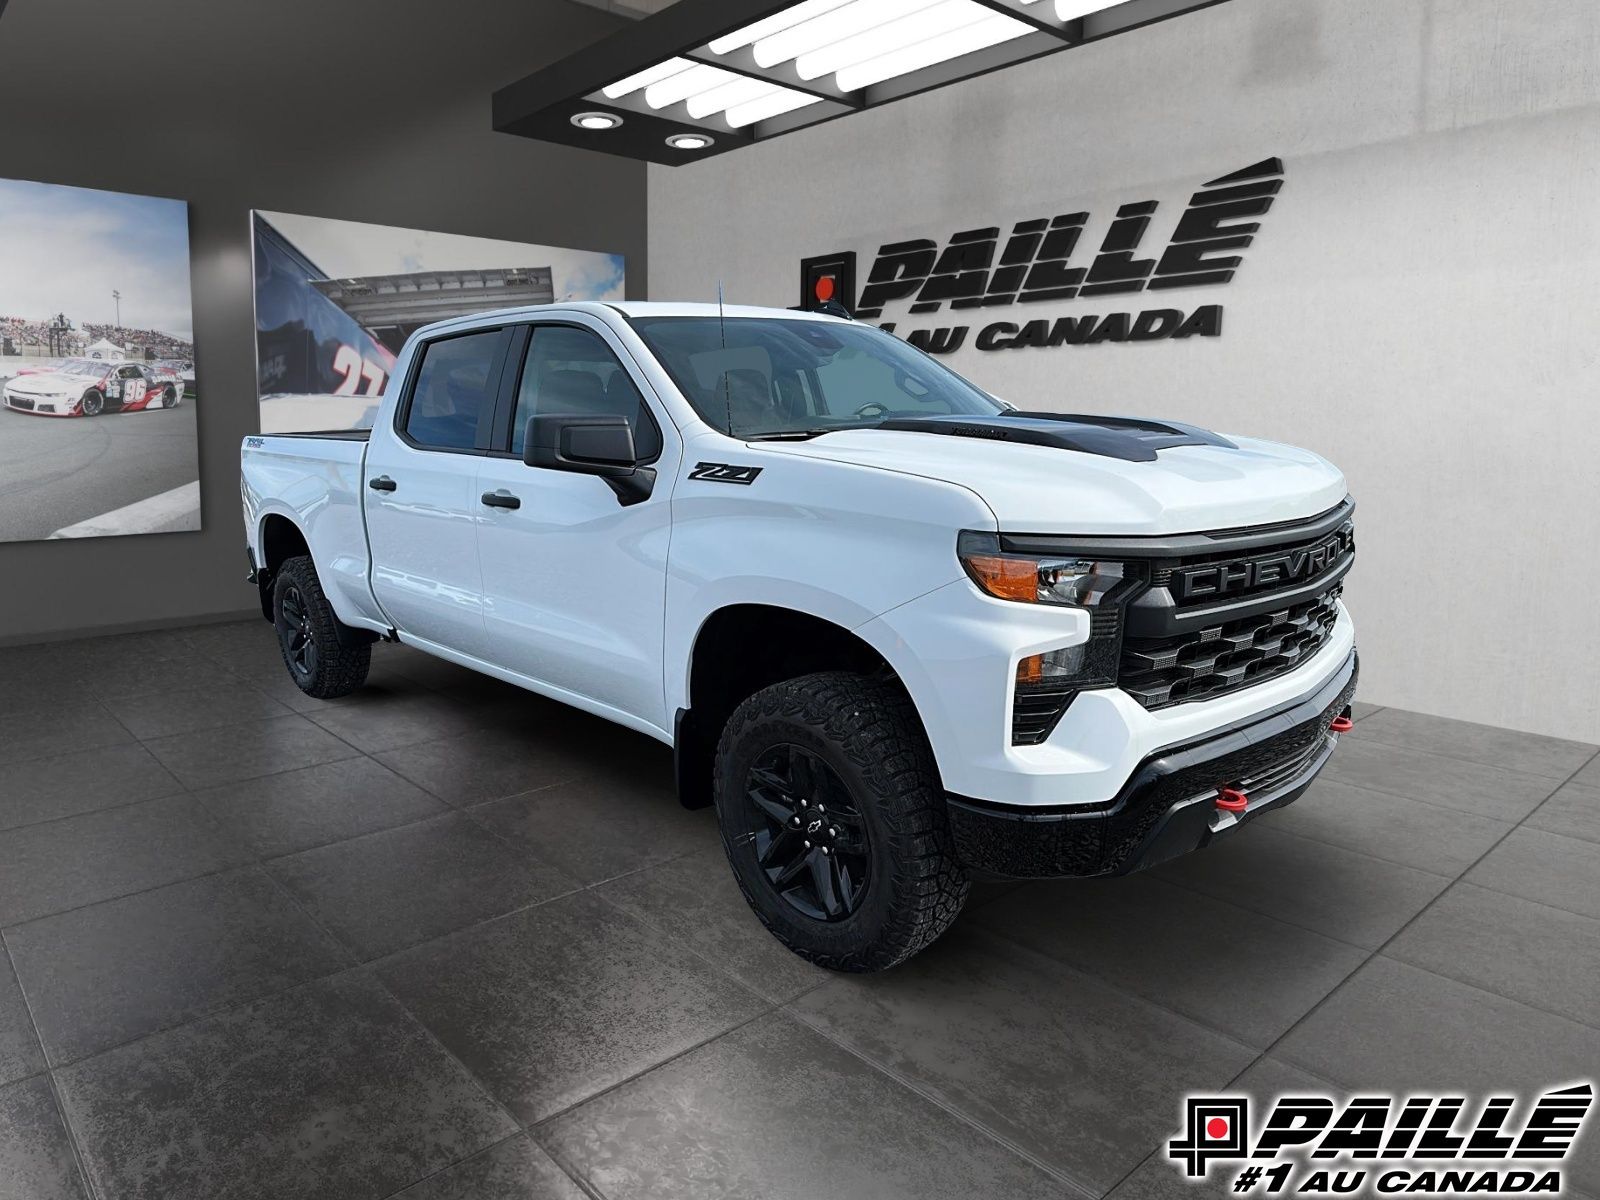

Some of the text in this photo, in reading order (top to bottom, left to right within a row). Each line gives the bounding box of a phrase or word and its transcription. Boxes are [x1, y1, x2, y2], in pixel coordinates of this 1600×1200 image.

[855, 156, 1284, 318] PAILLÉ
[975, 304, 1224, 351] CANADA
[1184, 525, 1354, 597] CHEVROLE
